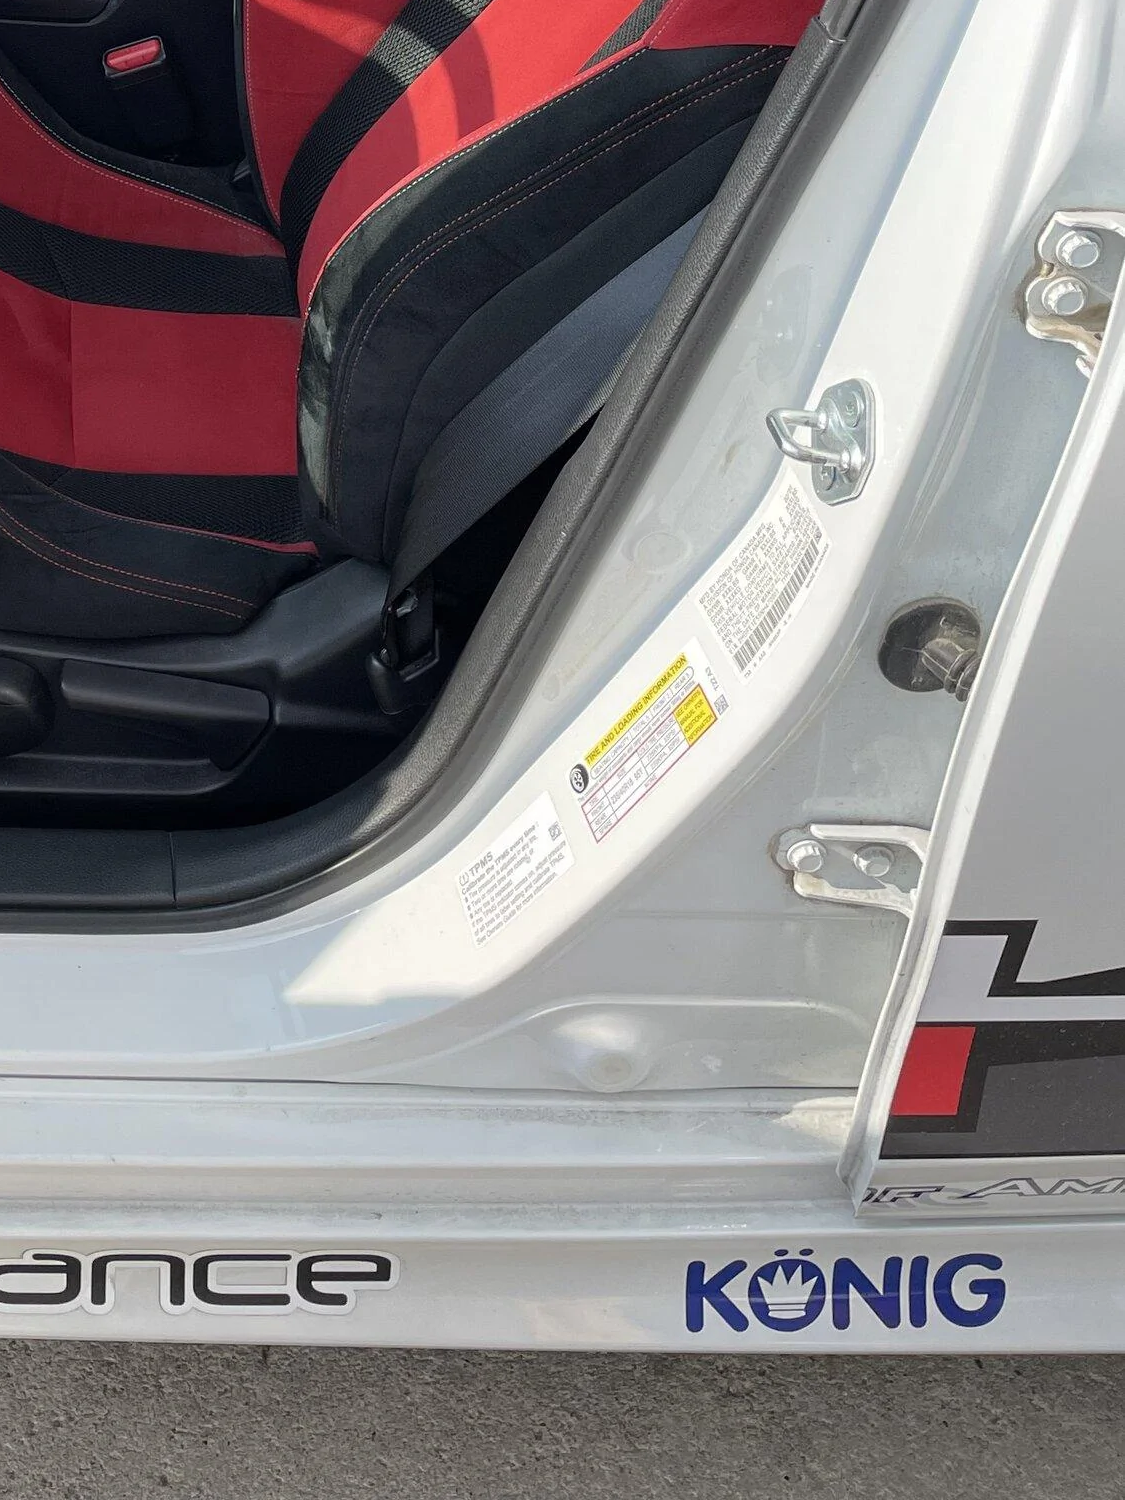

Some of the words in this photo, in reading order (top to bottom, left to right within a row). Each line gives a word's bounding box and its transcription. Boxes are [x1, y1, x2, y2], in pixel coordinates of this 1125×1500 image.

[714, 563, 732, 587] HONDA
[730, 555, 740, 568] OF
[737, 533, 757, 560] CANADA
[584, 744, 601, 766] TIRE
[599, 729, 616, 749] AND
[612, 699, 643, 735] LOADING
[641, 653, 687, 705] INFORMATION
[468, 849, 494, 879] TPMS
[493, 847, 510, 866] TPMS
[686, 1248, 1006, 1333] KÖNIG
